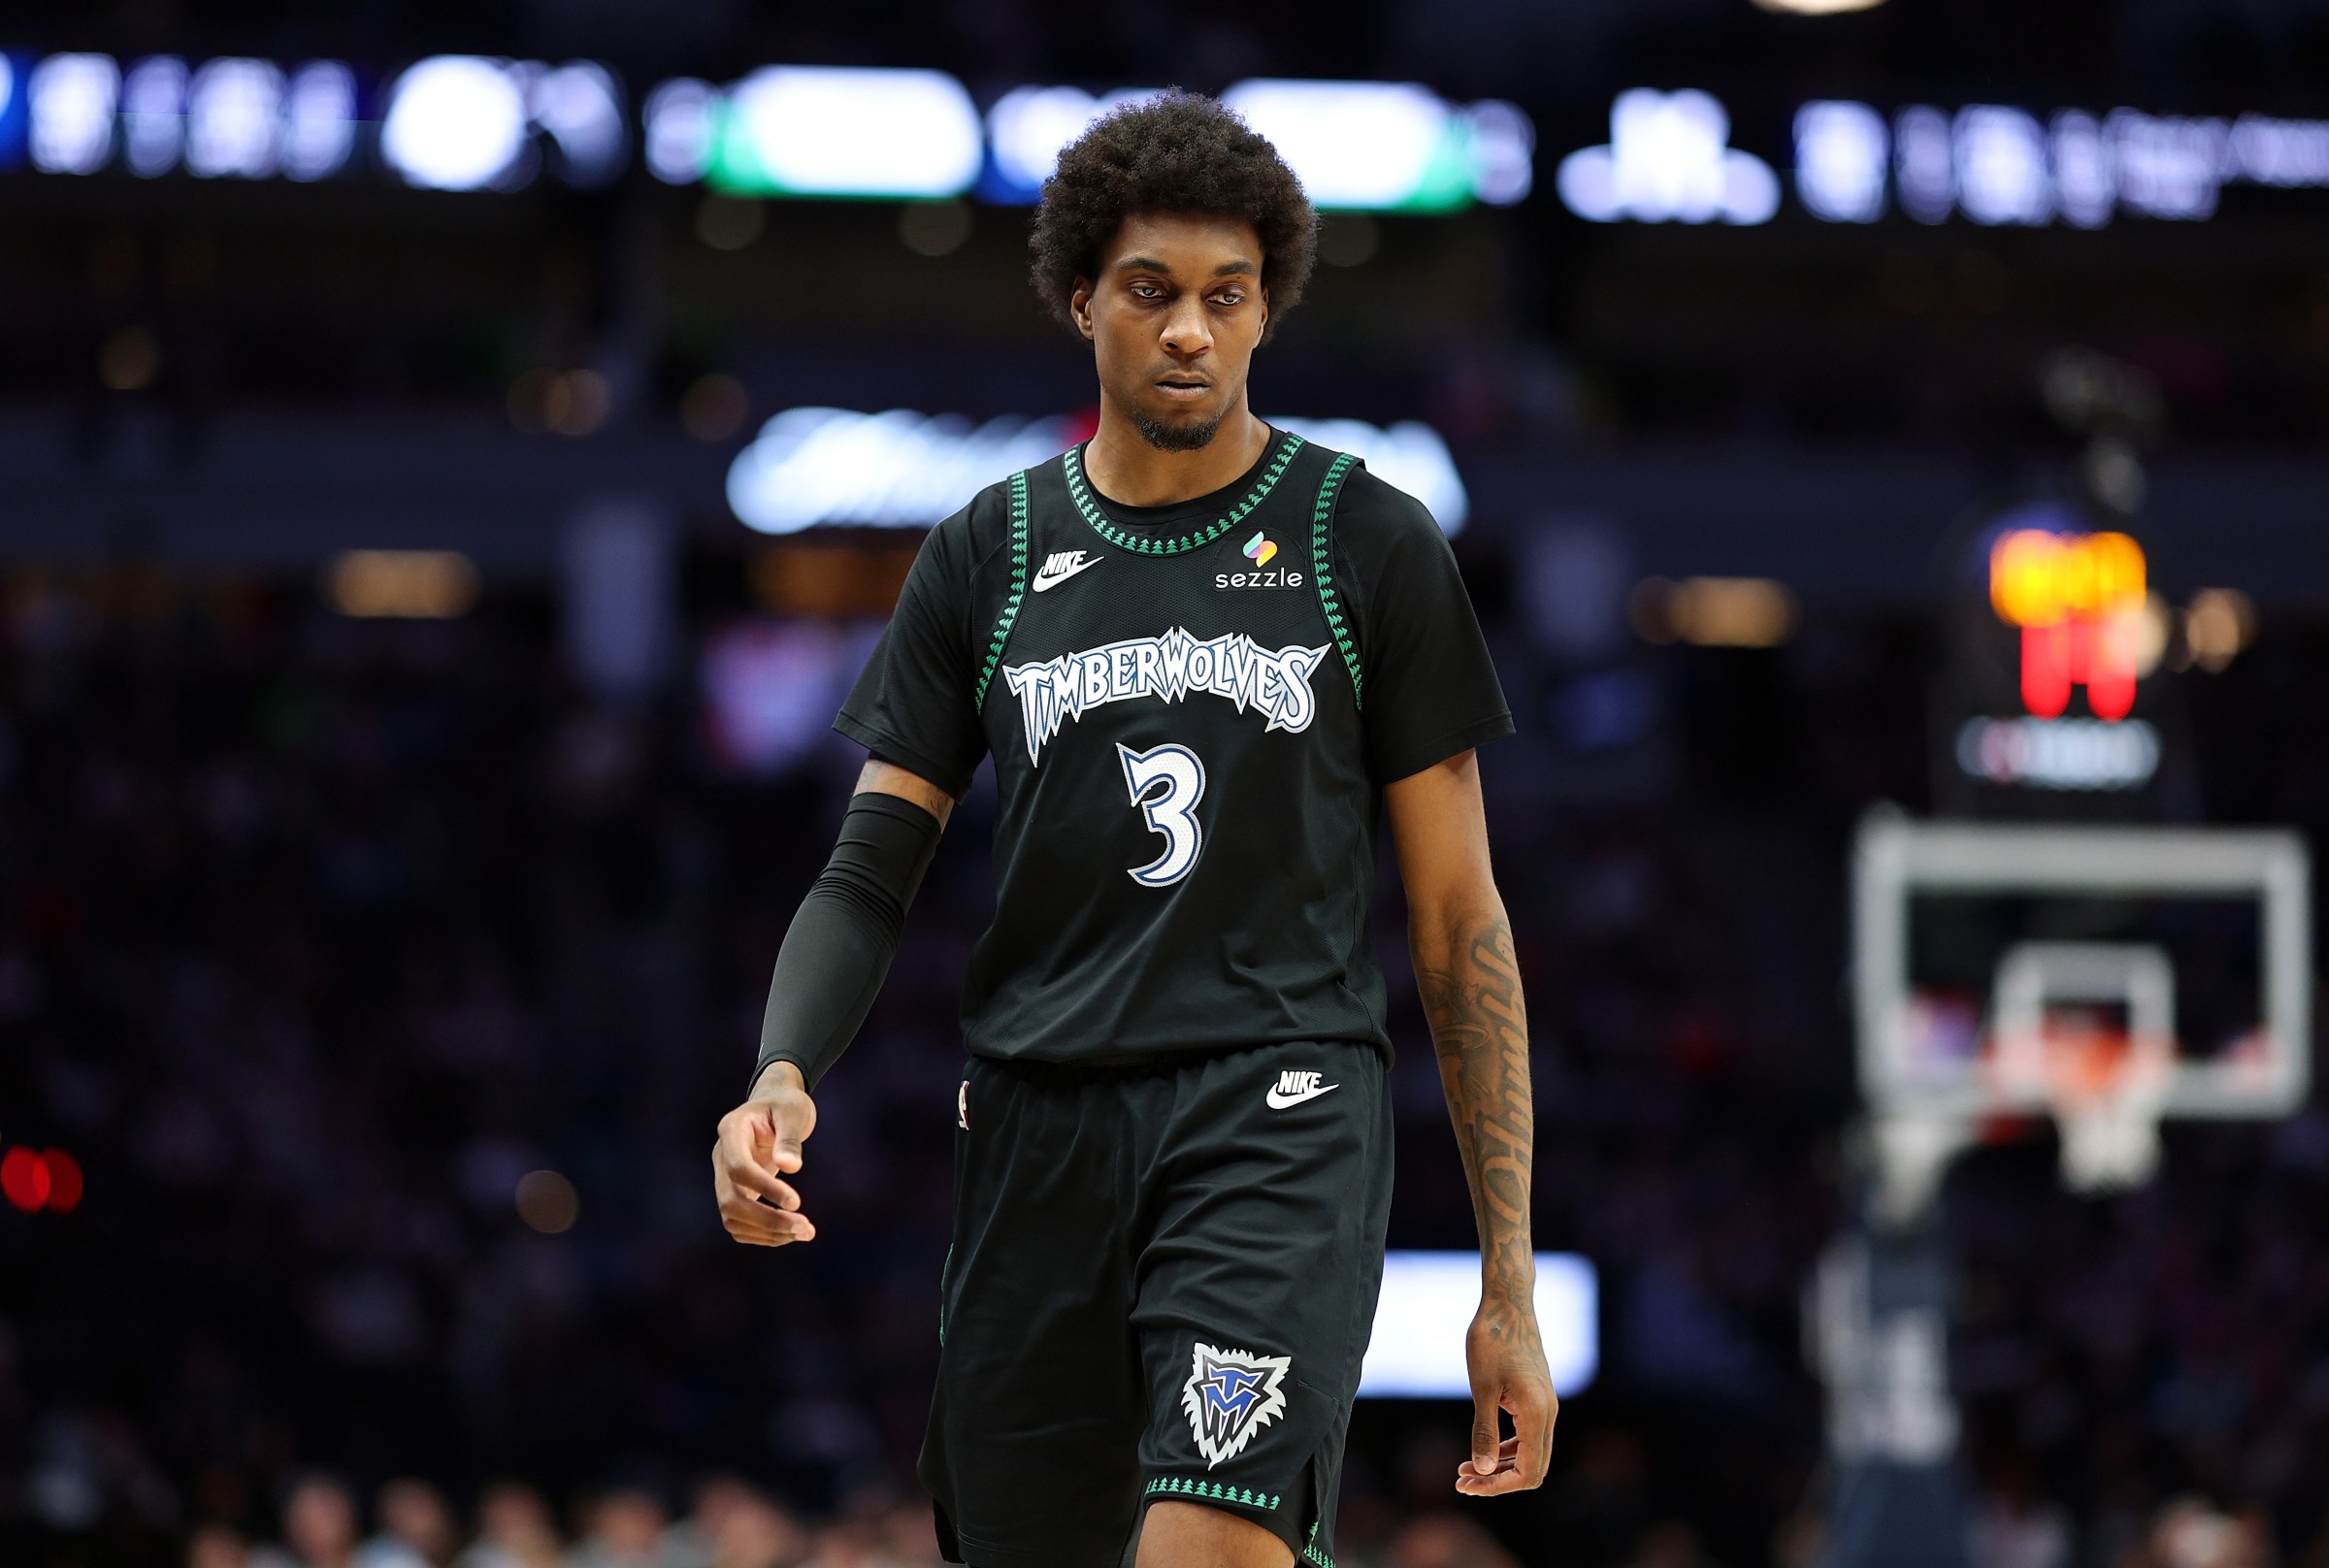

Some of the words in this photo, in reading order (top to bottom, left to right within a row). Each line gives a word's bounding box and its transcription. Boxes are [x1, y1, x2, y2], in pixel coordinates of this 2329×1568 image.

[1041, 550, 1088, 575] NIKE
[1215, 568, 1303, 588] sezzle
[1002, 626, 1332, 768] TIMBERWOLVES
[1115, 742, 1206, 888] 3
[1277, 1070, 1323, 1094] NIKE
